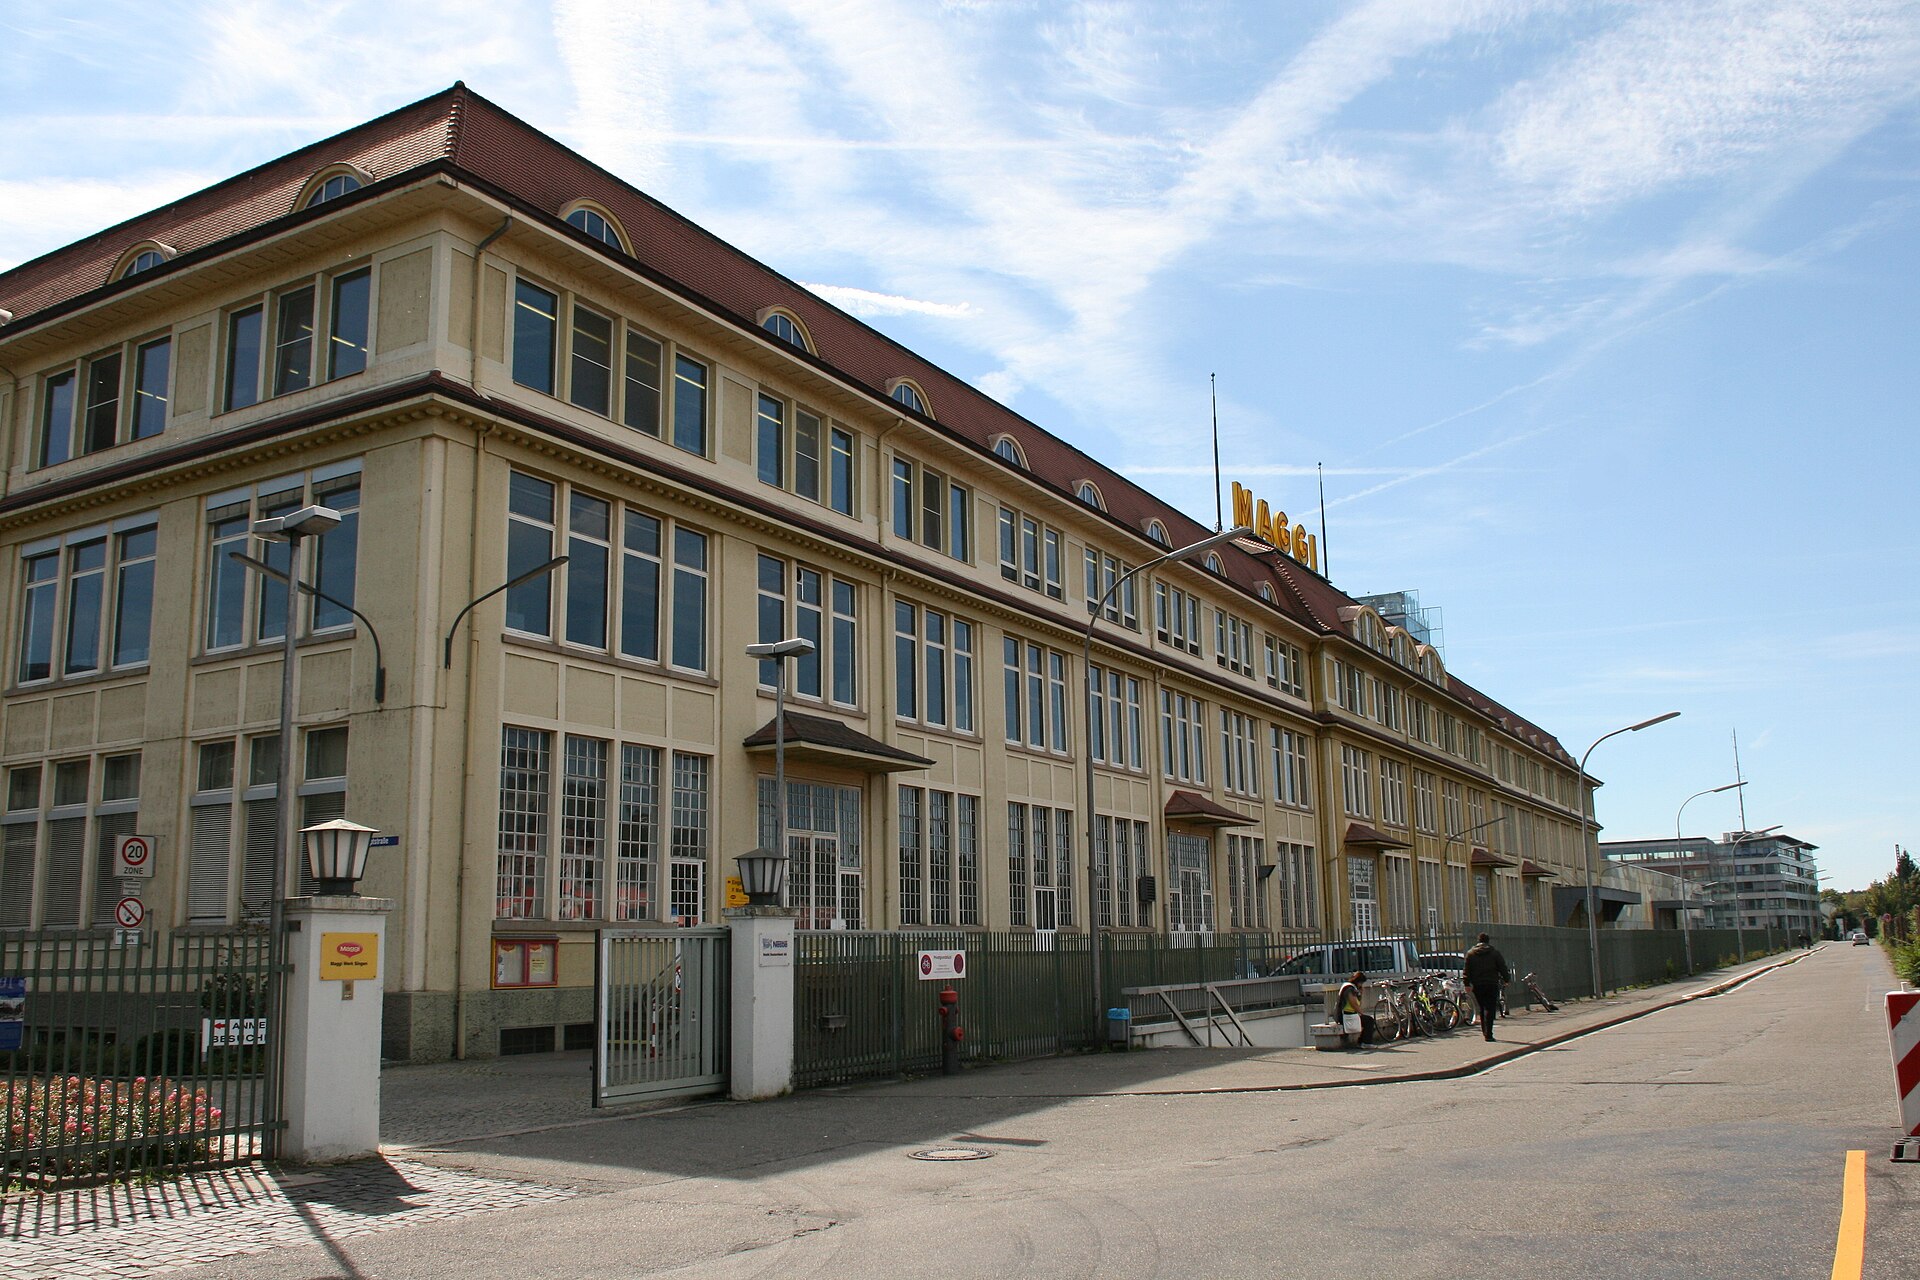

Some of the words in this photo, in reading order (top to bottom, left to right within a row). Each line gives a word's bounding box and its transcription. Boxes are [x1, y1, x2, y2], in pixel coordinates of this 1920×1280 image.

[1232, 481, 1318, 573] MAGGI
[127, 845, 143, 858] 20
[123, 866, 144, 874] ZONE
[212, 1034, 267, 1043] BESCH
